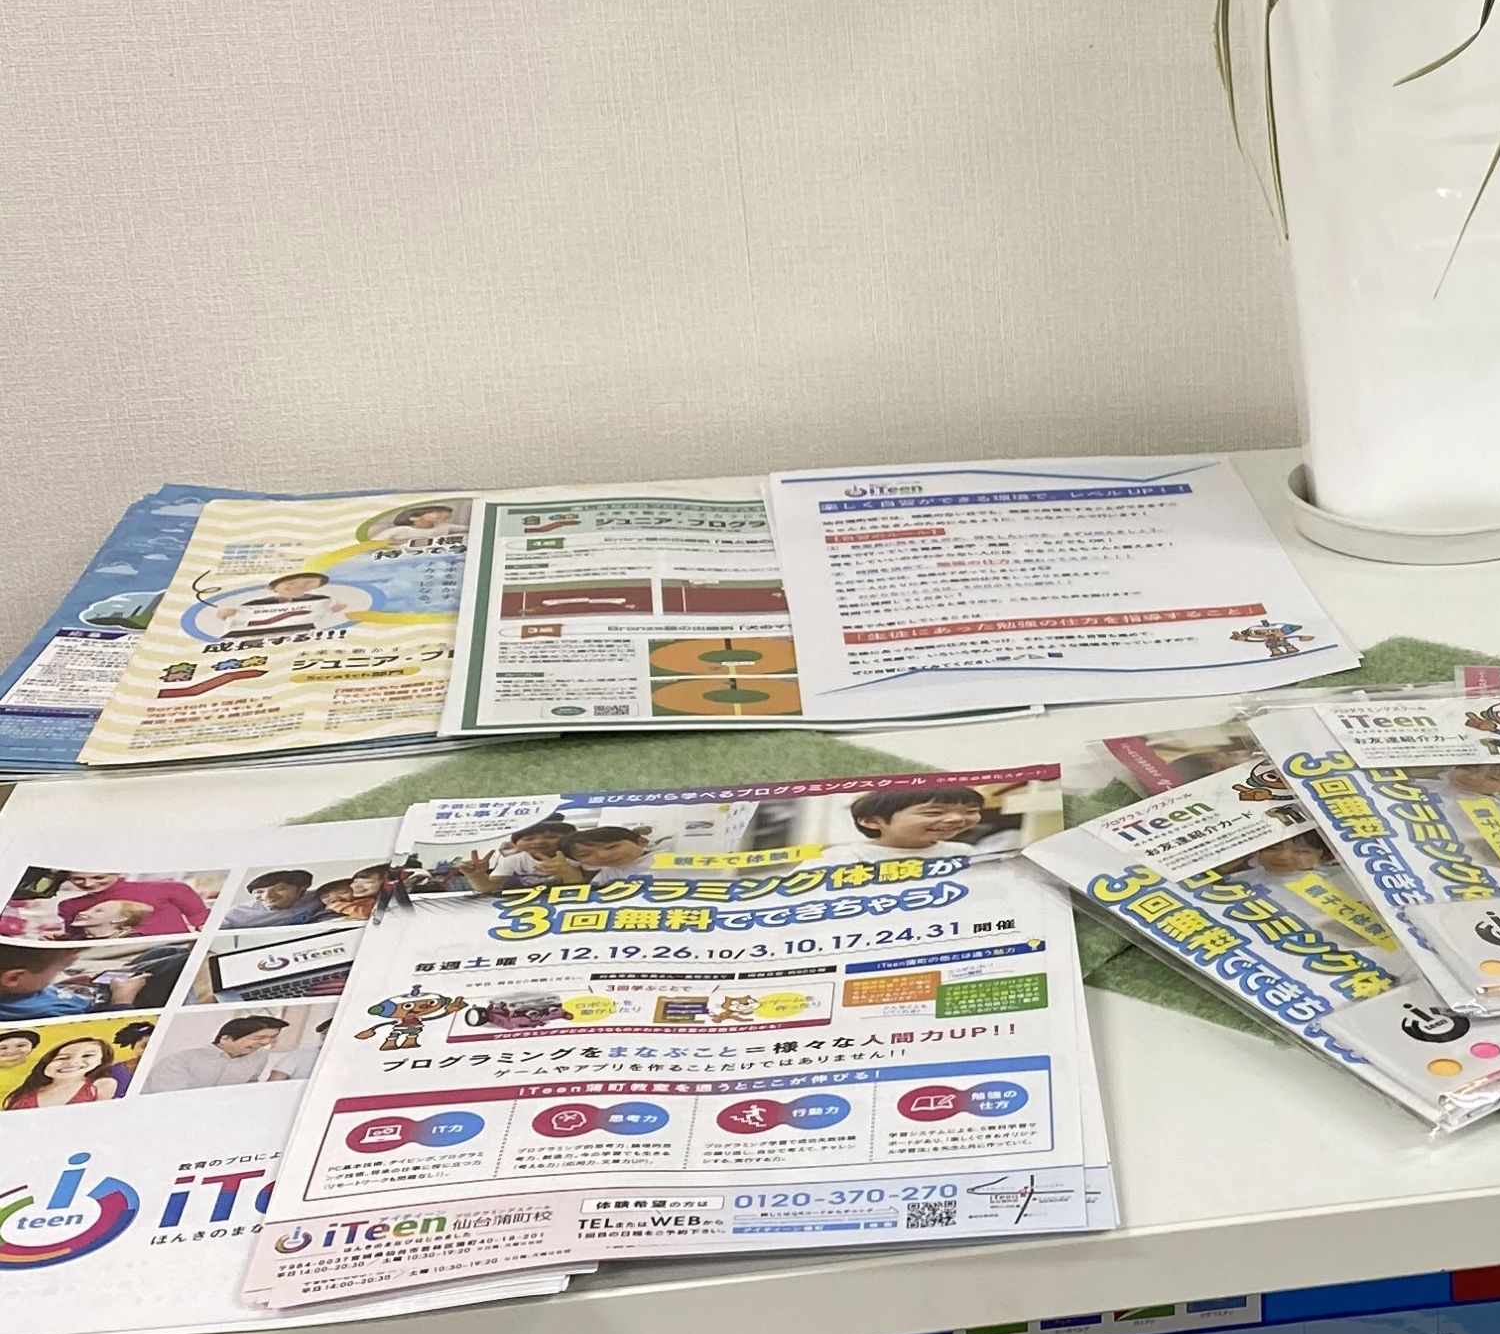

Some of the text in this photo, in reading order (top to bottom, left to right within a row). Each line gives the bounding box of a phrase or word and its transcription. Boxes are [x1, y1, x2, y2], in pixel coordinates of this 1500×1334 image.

[291, 649, 455, 671] ジュニア・プ
[1339, 714, 1440, 730] iTeen
[1112, 799, 1216, 843] iTeen
[500, 856, 964, 907] プログラミング体験が
[291, 945, 347, 964] iTeen
[791, 1104, 840, 1118] 行動力
[431, 1122, 464, 1135] IT力
[733, 1182, 958, 1210] 0120-370-270
[16, 1208, 84, 1232] teen
[322, 1214, 448, 1249] iTeen
